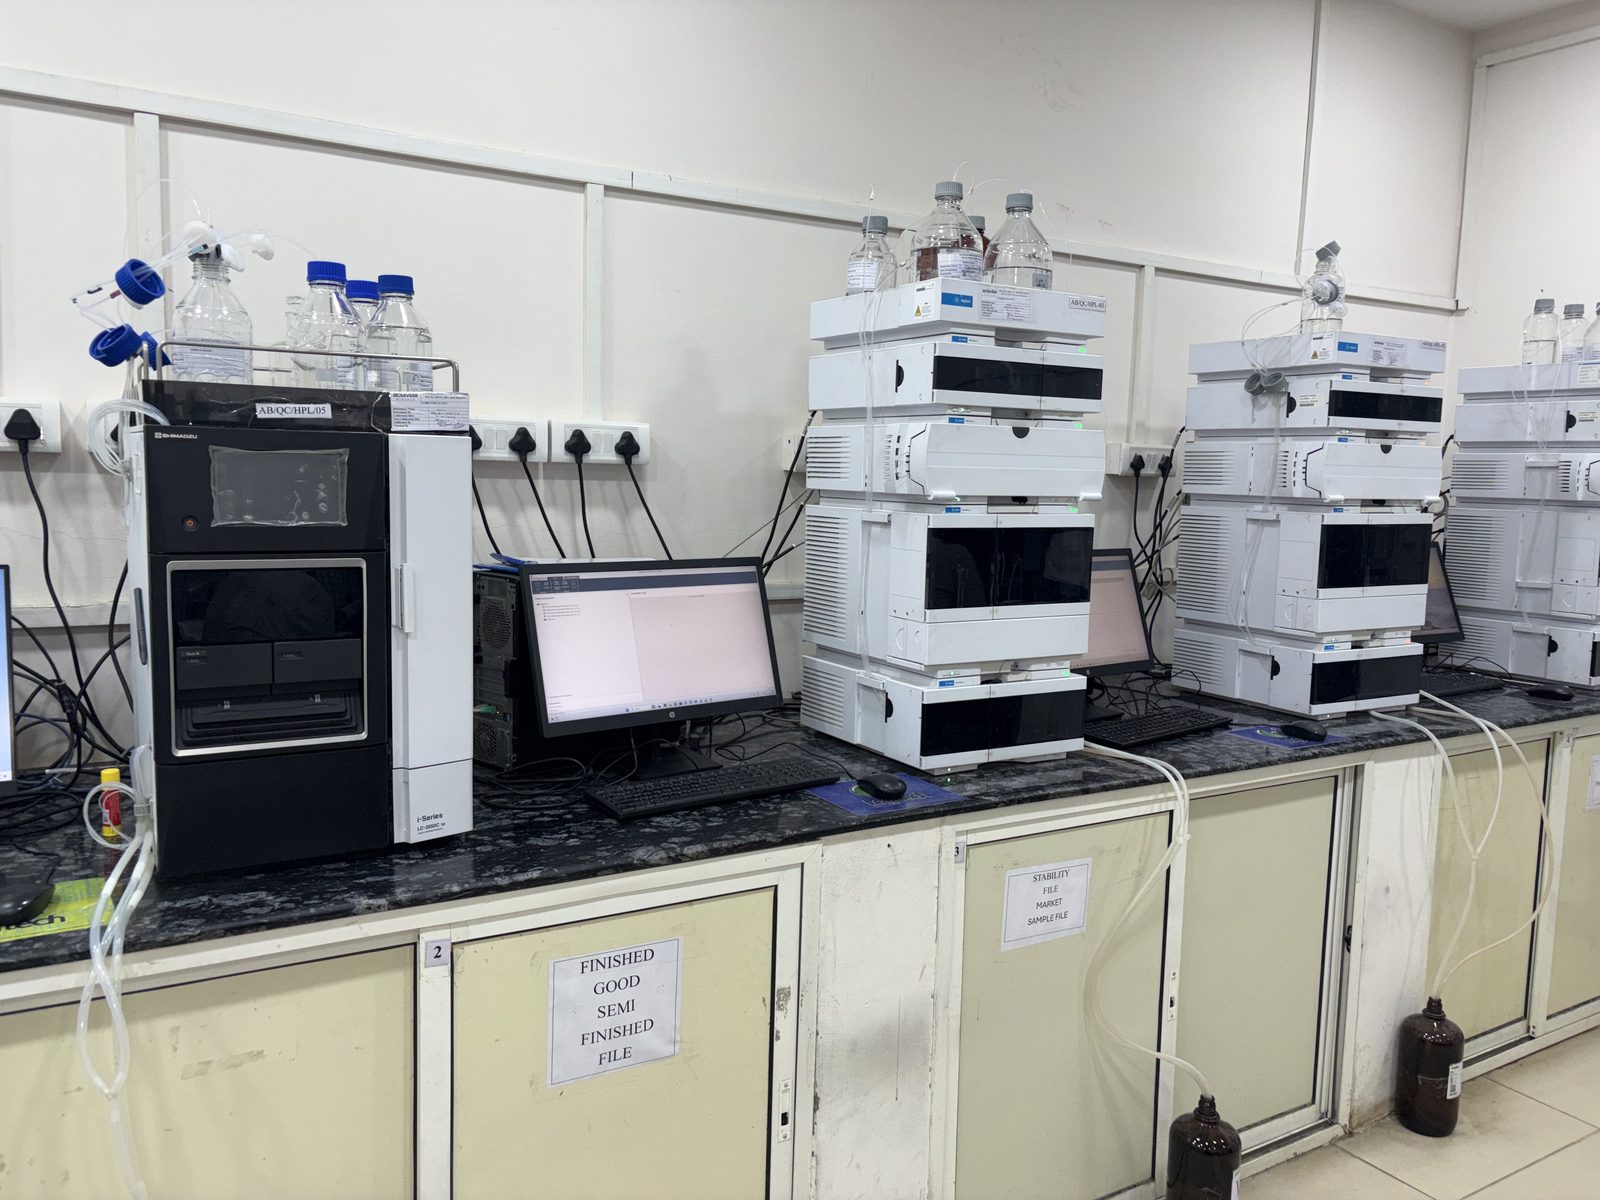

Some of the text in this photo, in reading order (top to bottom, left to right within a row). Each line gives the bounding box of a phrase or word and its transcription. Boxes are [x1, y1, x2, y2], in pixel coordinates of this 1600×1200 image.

[259, 406, 326, 416] AB/QC/HPL/05
[417, 813, 443, 823] i-Series
[954, 846, 960, 857] 3
[1033, 869, 1070, 882] STABILITY
[1043, 885, 1059, 895] FILE
[1036, 898, 1062, 909] MARKET
[1027, 911, 1069, 926] SAMPLE FILE
[433, 945, 442, 959] 2
[580, 948, 655, 974] FINISHED
[593, 974, 641, 995] GOOD
[597, 999, 636, 1019] SEMI
[581, 1018, 654, 1046] FINISHED
[598, 1046, 633, 1066] FILE
